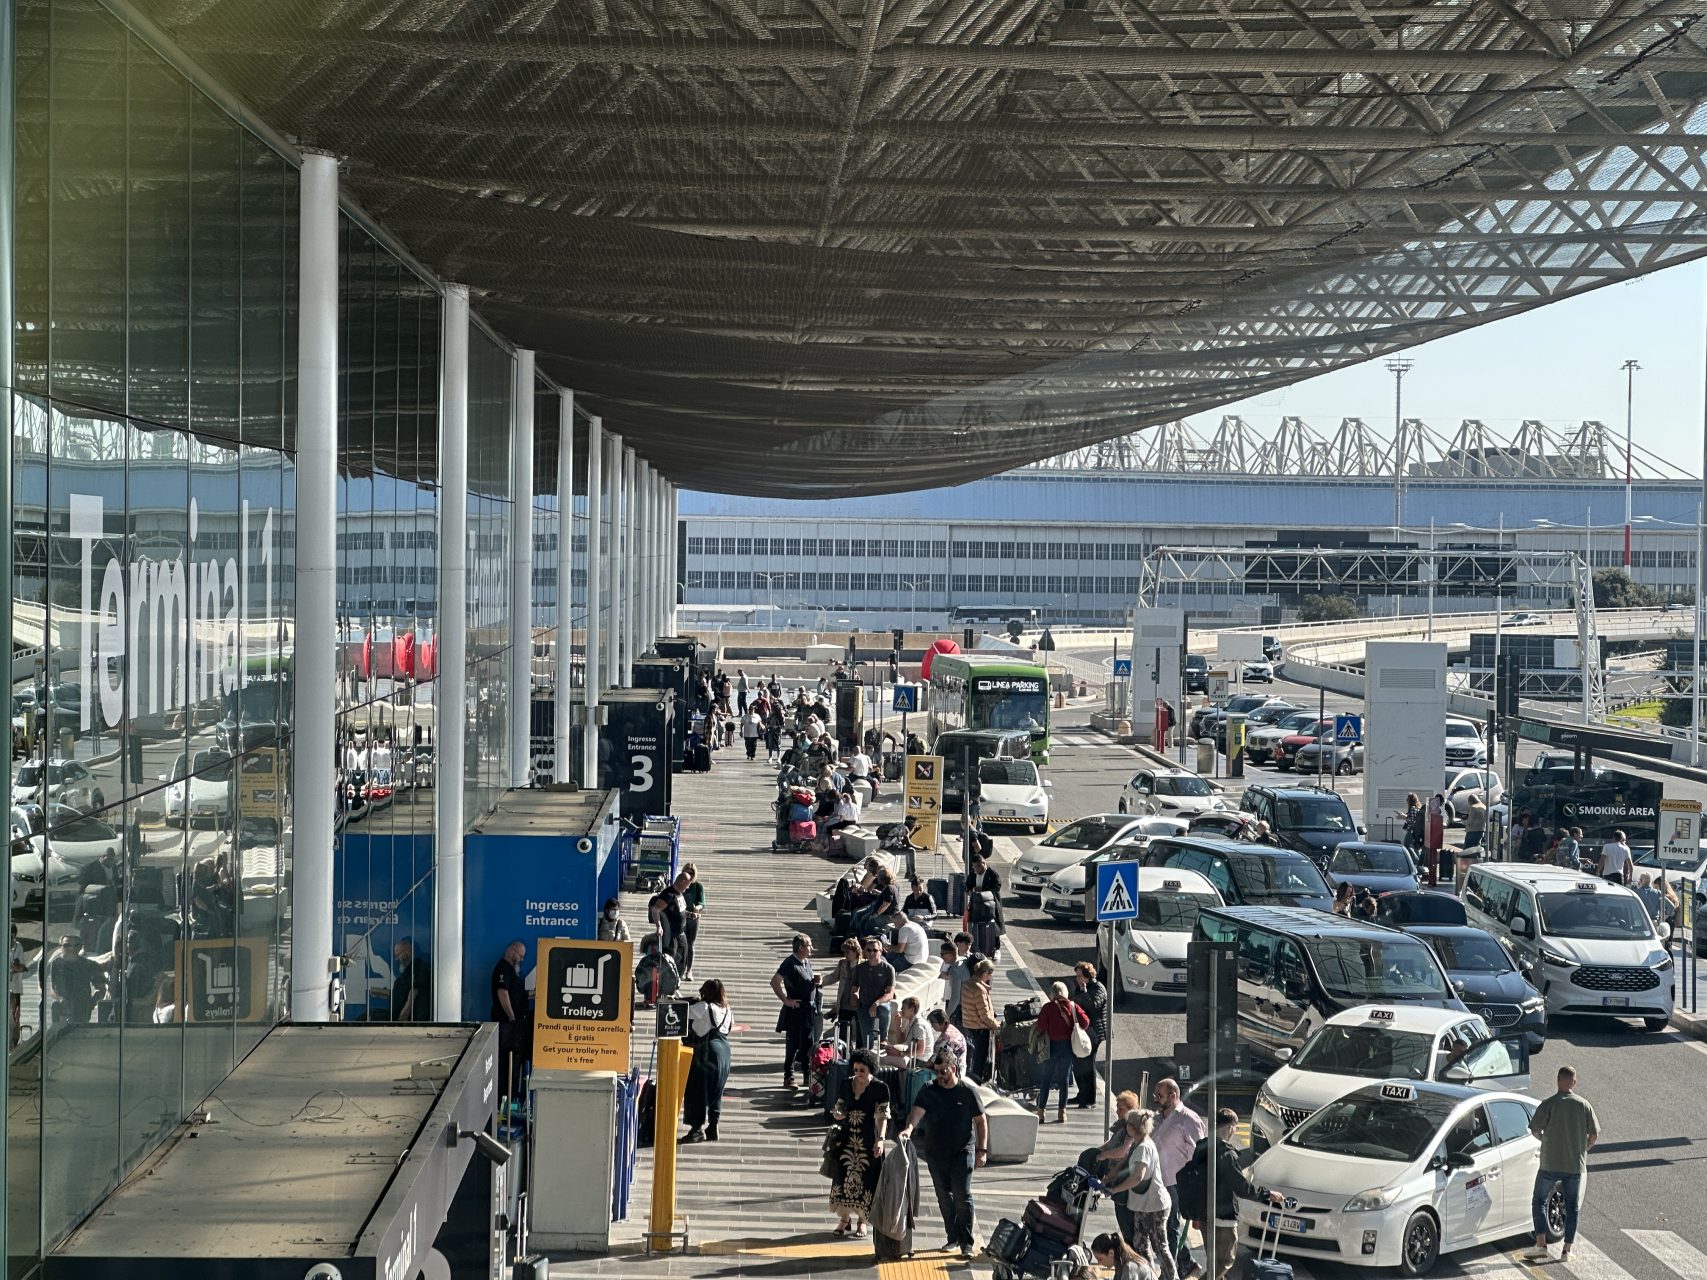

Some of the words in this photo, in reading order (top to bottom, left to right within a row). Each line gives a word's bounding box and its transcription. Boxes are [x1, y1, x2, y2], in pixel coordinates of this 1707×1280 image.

[469, 528, 504, 629] Terminal
[69, 493, 249, 732] Terminal
[261, 505, 274, 677] 1
[991, 680, 1011, 690] LINEA
[1011, 680, 1039, 690] PARKING
[627, 735, 657, 743] Ingresso
[627, 743, 657, 751] Entrance
[628, 756, 654, 793] 3
[1578, 805, 1627, 816] SMOKING
[1628, 807, 1656, 816] AREA
[1660, 802, 1701, 810] PARCOMETRO
[525, 898, 579, 913] Ingresso
[525, 914, 579, 927] Entrance
[561, 1006, 604, 1019] Trolleys
[1372, 1011, 1393, 1019] TAXI
[562, 1024, 575, 1033] qui
[597, 1025, 626, 1033] carrello.
[574, 1034, 595, 1042] gratis
[557, 1047, 574, 1055] your
[575, 1047, 600, 1056] trolley
[1385, 1086, 1407, 1098] TAXI
